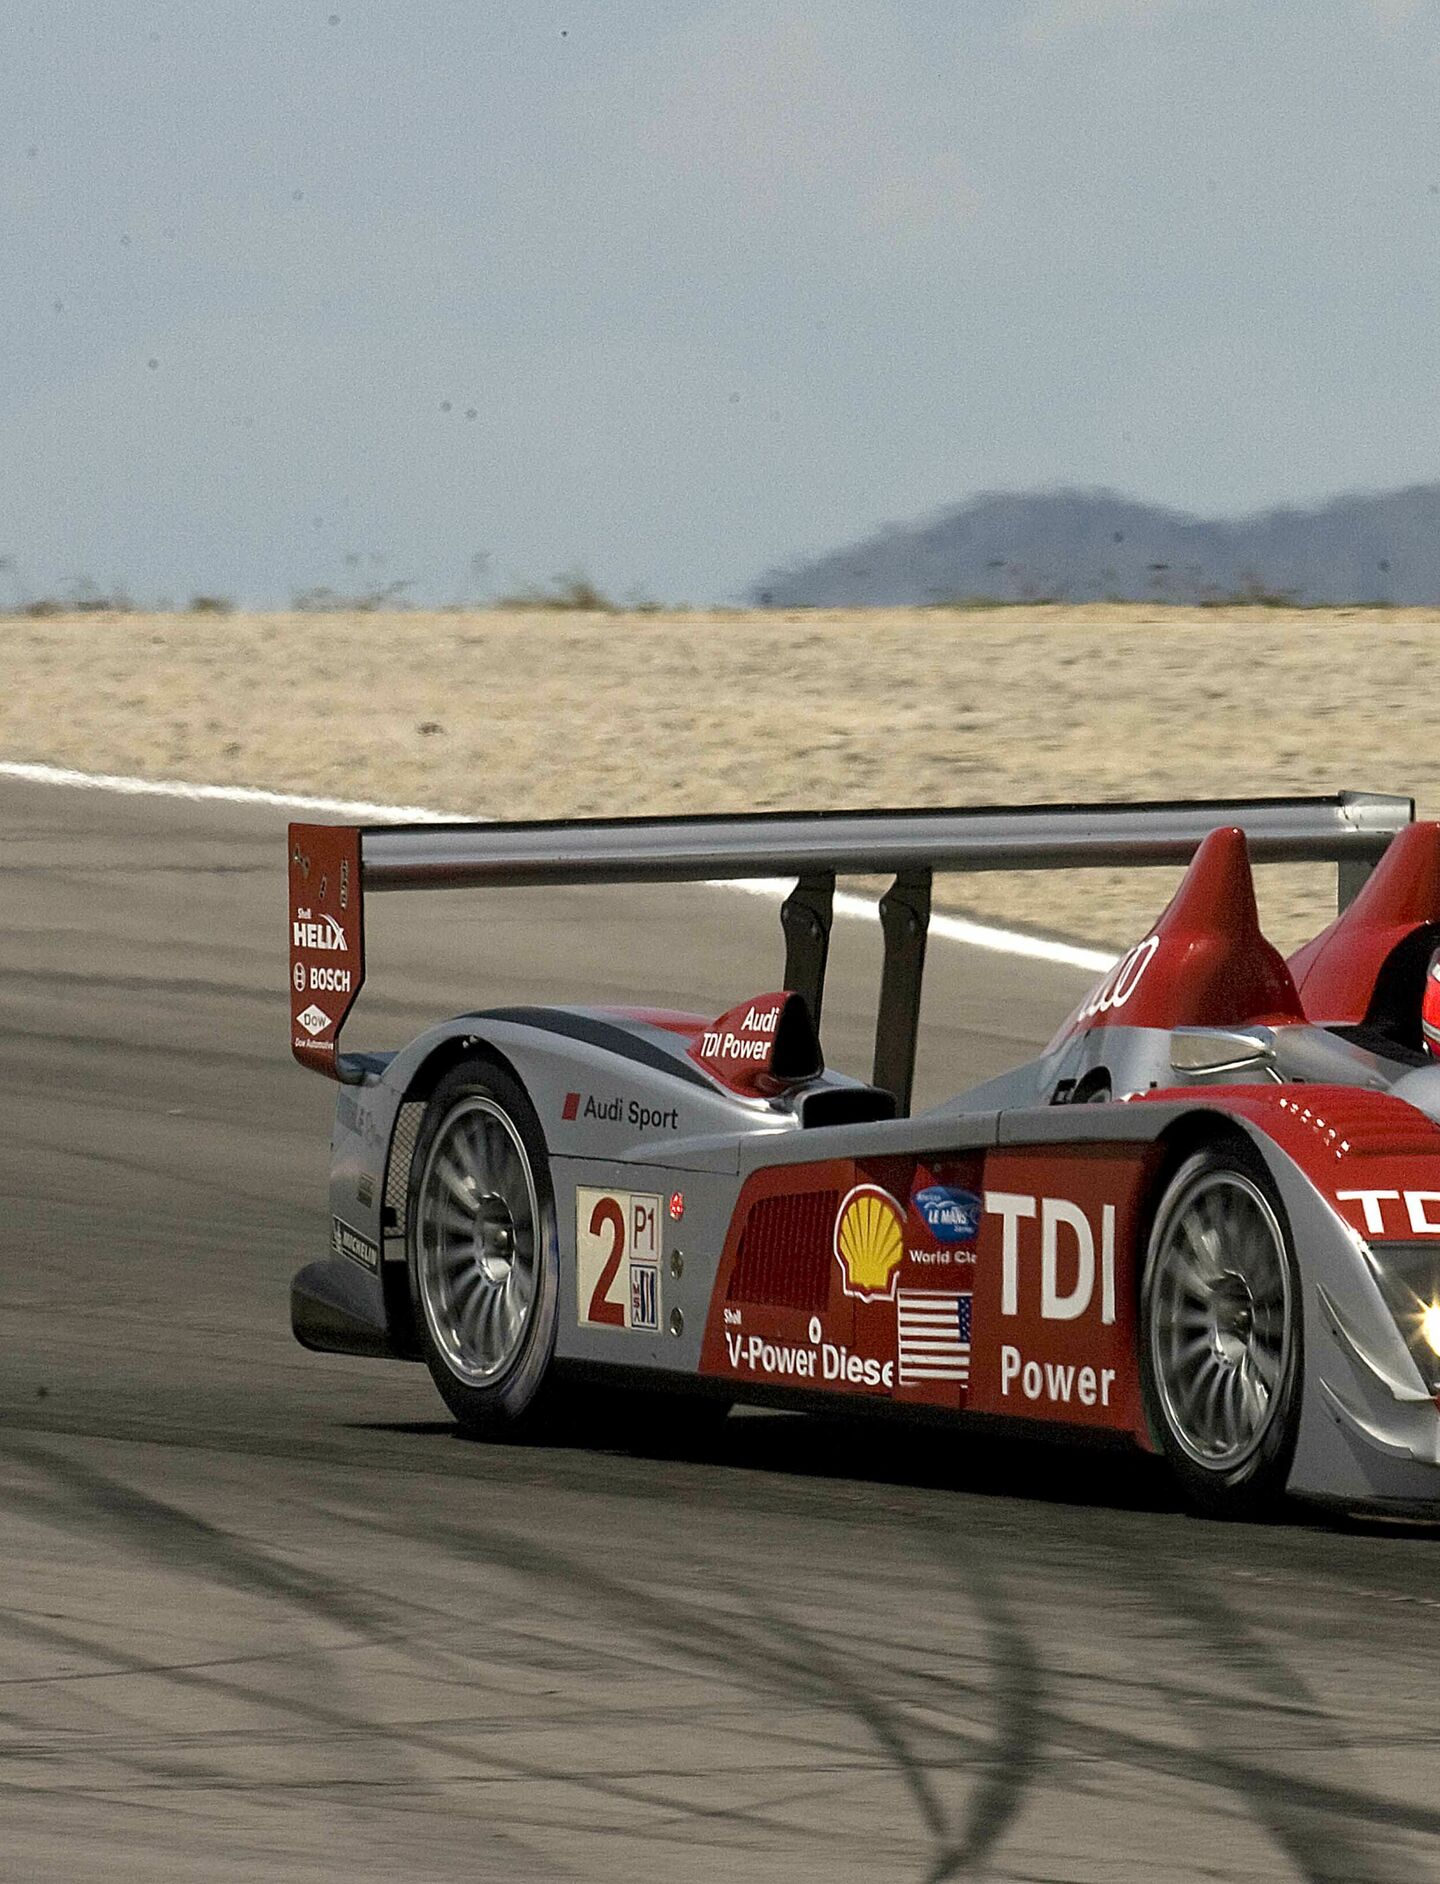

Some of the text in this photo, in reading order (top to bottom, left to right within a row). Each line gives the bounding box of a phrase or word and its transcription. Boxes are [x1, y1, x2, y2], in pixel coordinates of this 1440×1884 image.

[293, 913, 348, 950] HELIX
[310, 967, 351, 992] BOSCH
[304, 1013, 326, 1027] Dow
[741, 1006, 780, 1032] Audi
[700, 1033, 772, 1060] TDI Power
[584, 1095, 679, 1131] Audi Sport
[634, 1205, 654, 1251] P1
[342, 1231, 378, 1266] MICHELIN
[588, 1197, 625, 1327] 2
[909, 1249, 949, 1264] World
[984, 1191, 1116, 1325] TDI
[724, 1308, 742, 1325] Shell
[725, 1331, 817, 1377] V-Power
[1002, 1345, 1116, 1407] Power
